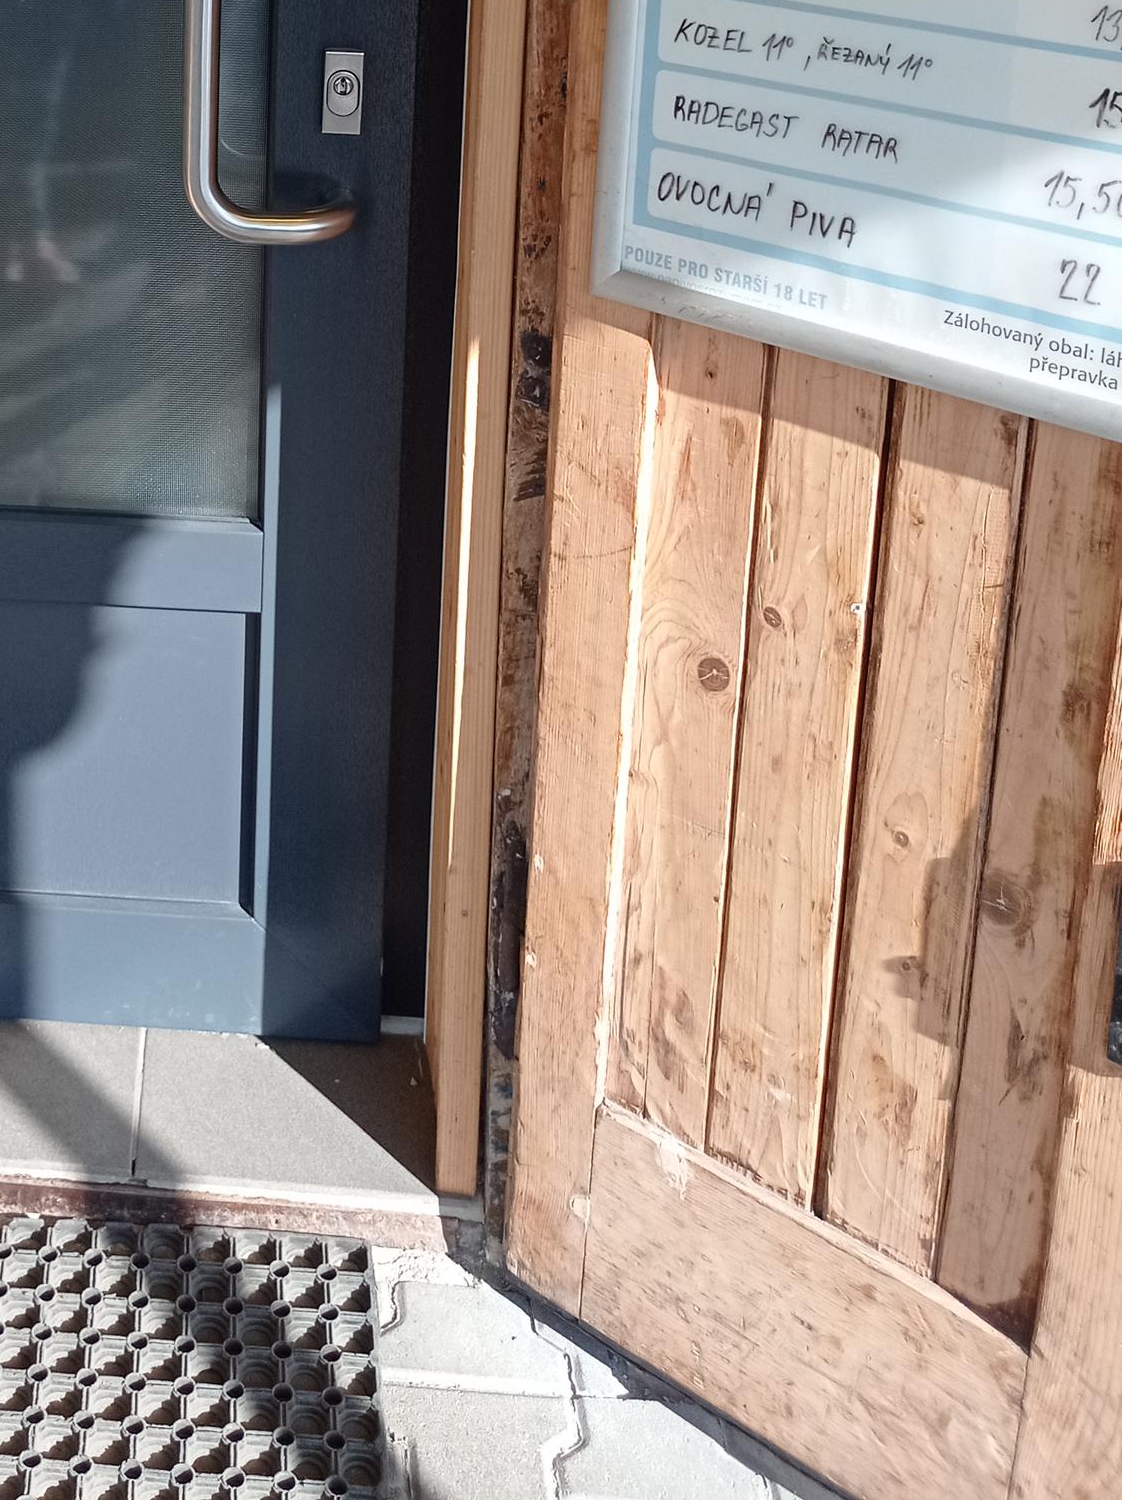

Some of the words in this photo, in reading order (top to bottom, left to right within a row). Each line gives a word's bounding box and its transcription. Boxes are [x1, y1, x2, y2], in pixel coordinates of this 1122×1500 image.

[674, 18, 752, 54] KOZEL
[762, 33, 794, 62] 11°
[897, 53, 933, 81] 11°
[674, 95, 800, 140] RADEGAST
[821, 123, 899, 164] RATAR
[657, 170, 774, 221] OVOCNÁ
[790, 200, 857, 248] PIVA
[624, 245, 672, 270] POUZE
[678, 258, 708, 280] PRO
[714, 267, 769, 295] STARŠÍ
[774, 282, 793, 301] 18
[799, 289, 828, 310] LET
[1059, 258, 1101, 306] 22
[943, 309, 1044, 351] Zálohovaný
[1048, 338, 1094, 361] obal:
[1029, 356, 1119, 390] přepravka
